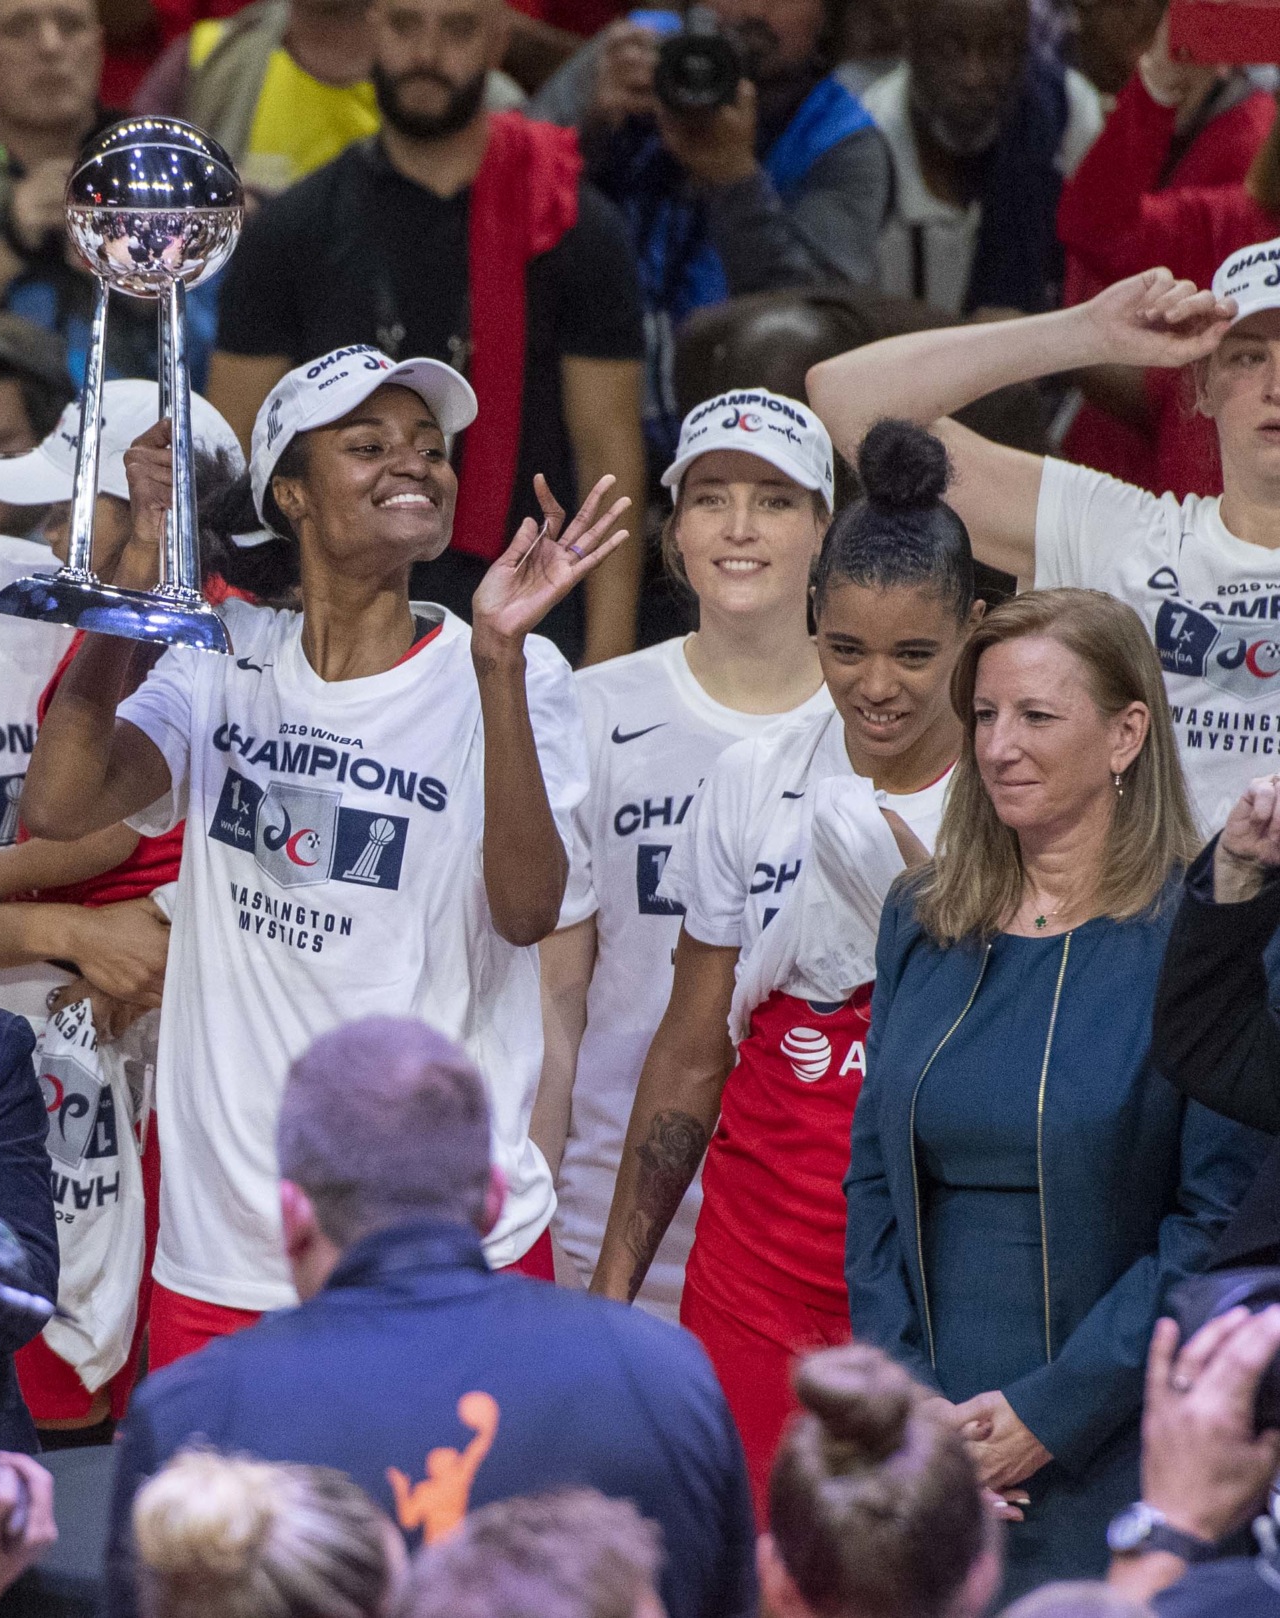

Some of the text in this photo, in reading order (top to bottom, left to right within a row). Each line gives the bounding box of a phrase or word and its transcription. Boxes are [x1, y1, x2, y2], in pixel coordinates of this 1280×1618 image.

[690, 394, 807, 428] CHAMPIONS
[1218, 582, 1261, 596] 2019
[311, 726, 364, 749] WNBA
[1187, 730, 1280, 755] MYSTIC
[213, 723, 448, 812] CHAMPIONS
[221, 817, 252, 840] WNBA
[230, 881, 353, 936] WASHINGTON
[239, 910, 324, 953] MYSTICS
